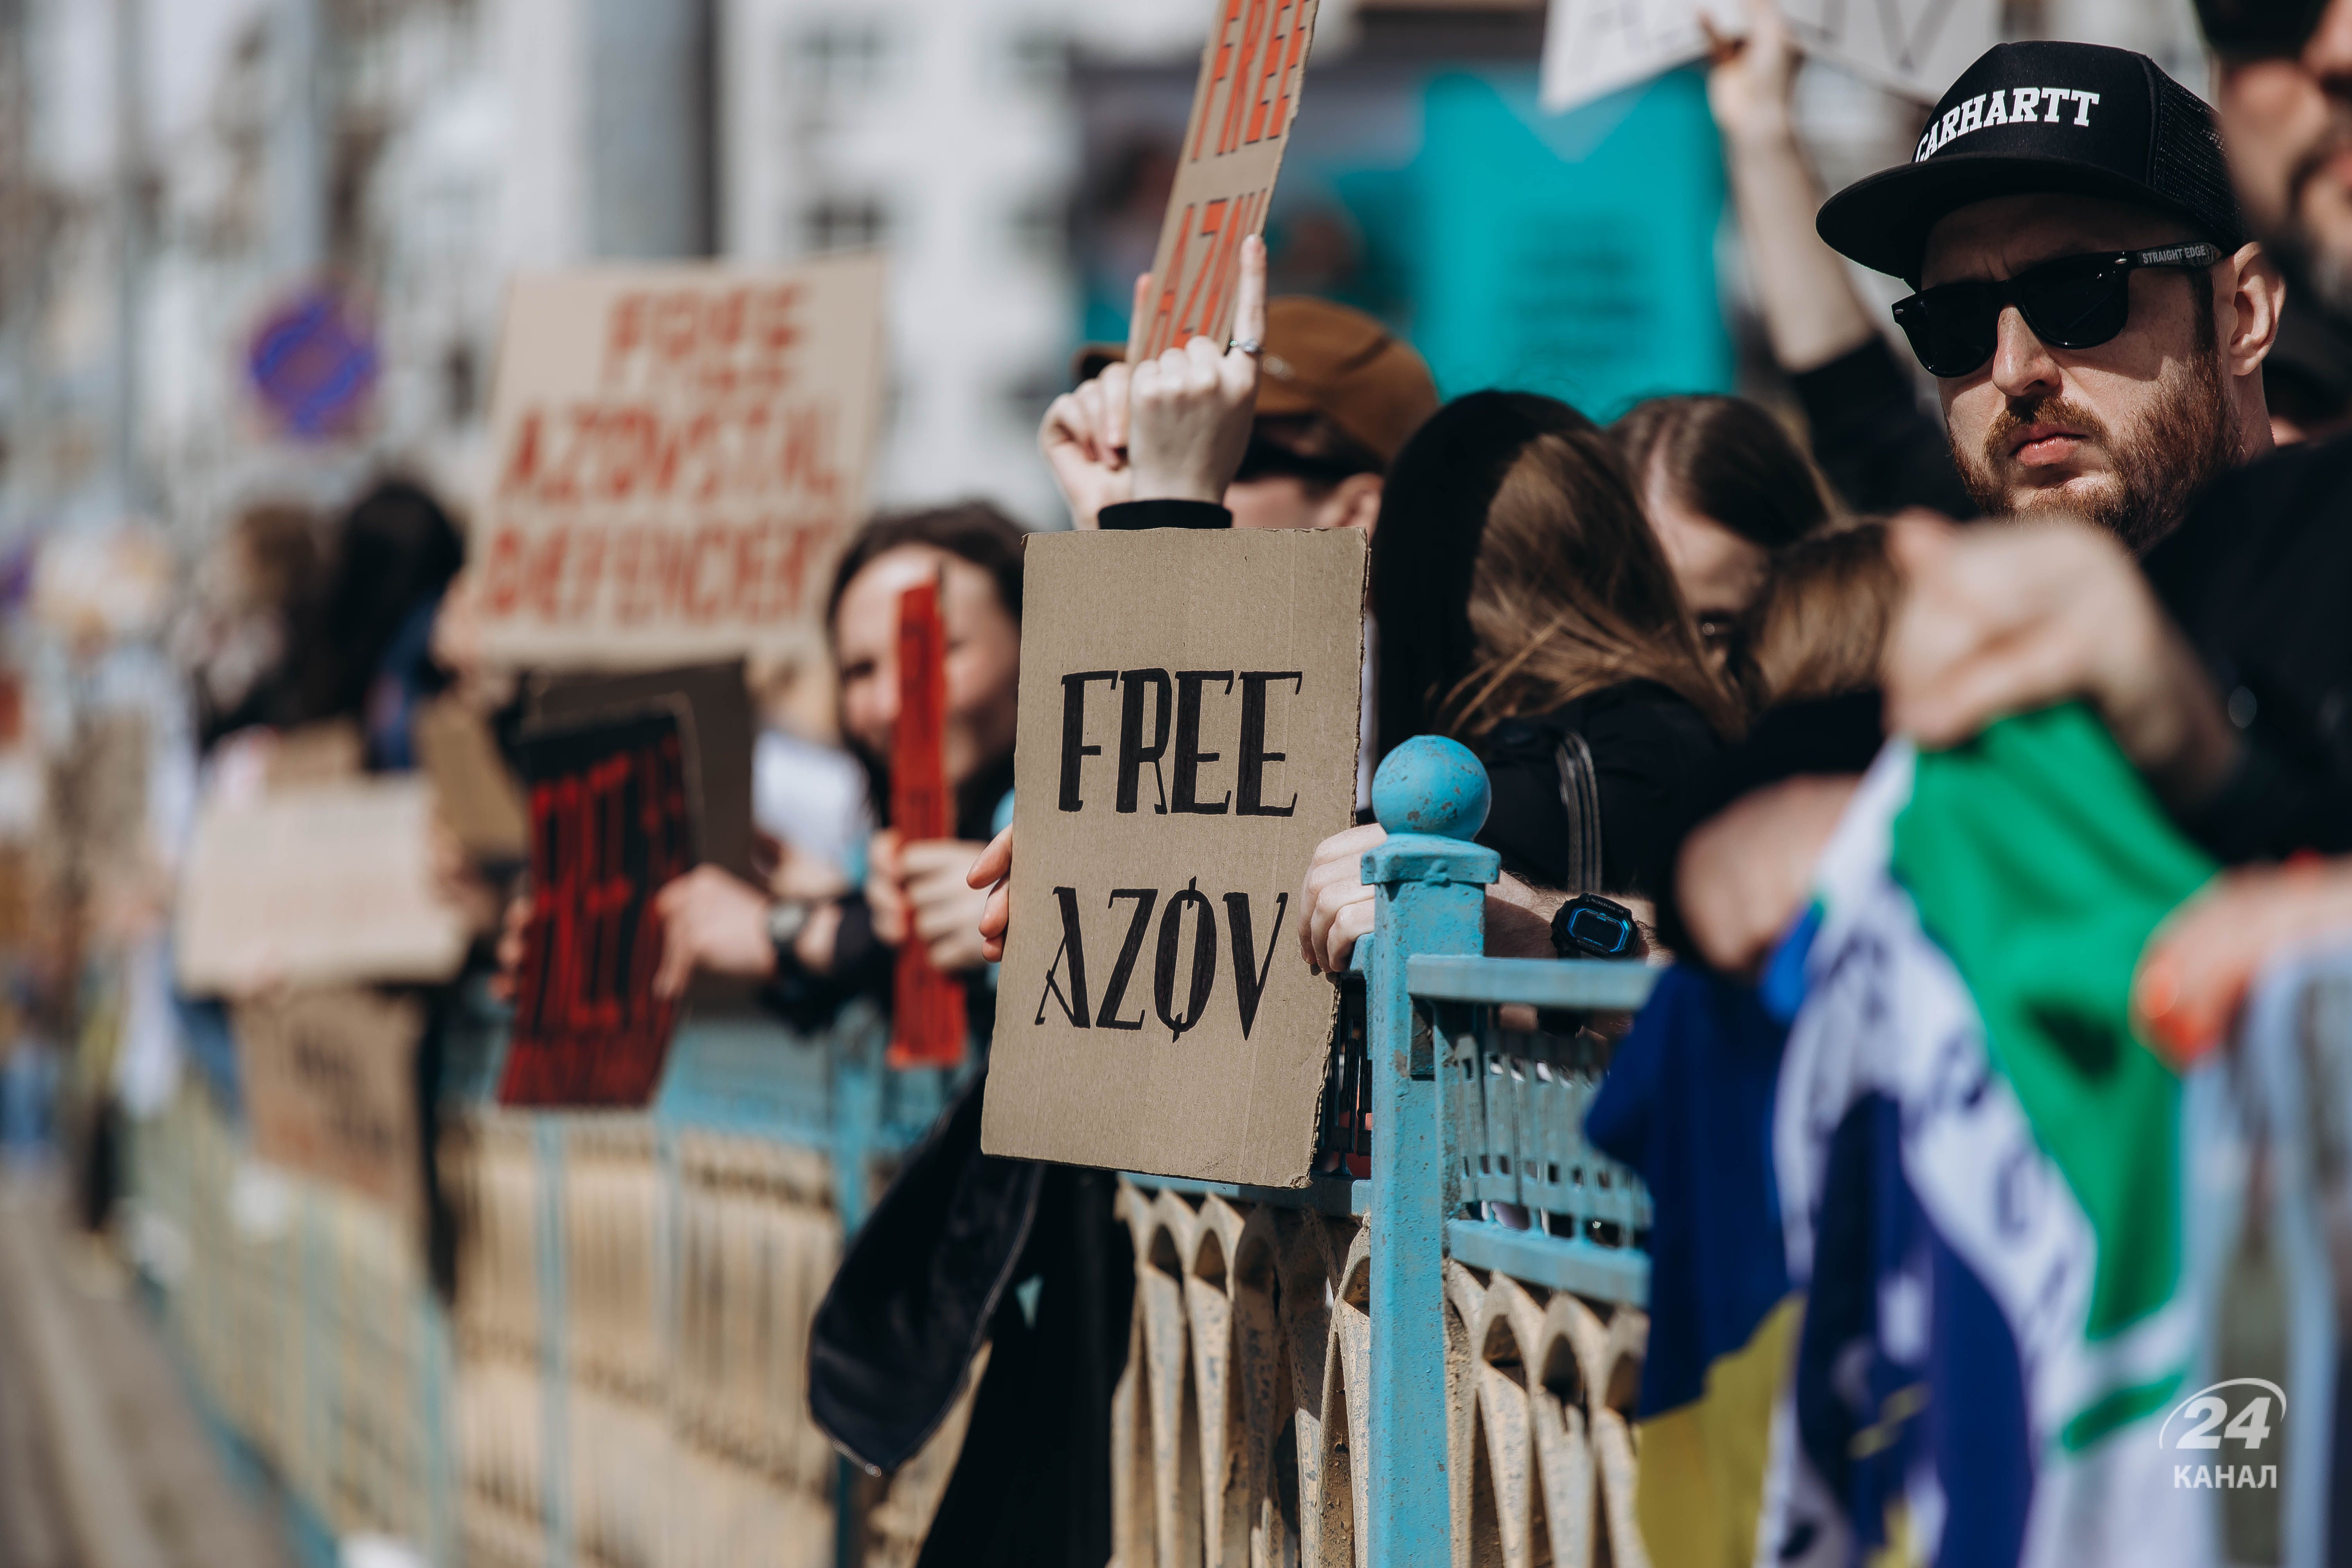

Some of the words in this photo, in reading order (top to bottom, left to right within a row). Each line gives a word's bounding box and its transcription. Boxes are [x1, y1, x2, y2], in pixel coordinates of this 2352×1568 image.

[1191, 0, 1310, 163] FREE
[1915, 87, 2100, 163] CARHARTT
[2142, 249, 2183, 264] STRAIGHT
[2185, 246, 2206, 258] EDGE
[1058, 668, 1303, 817] FREE
